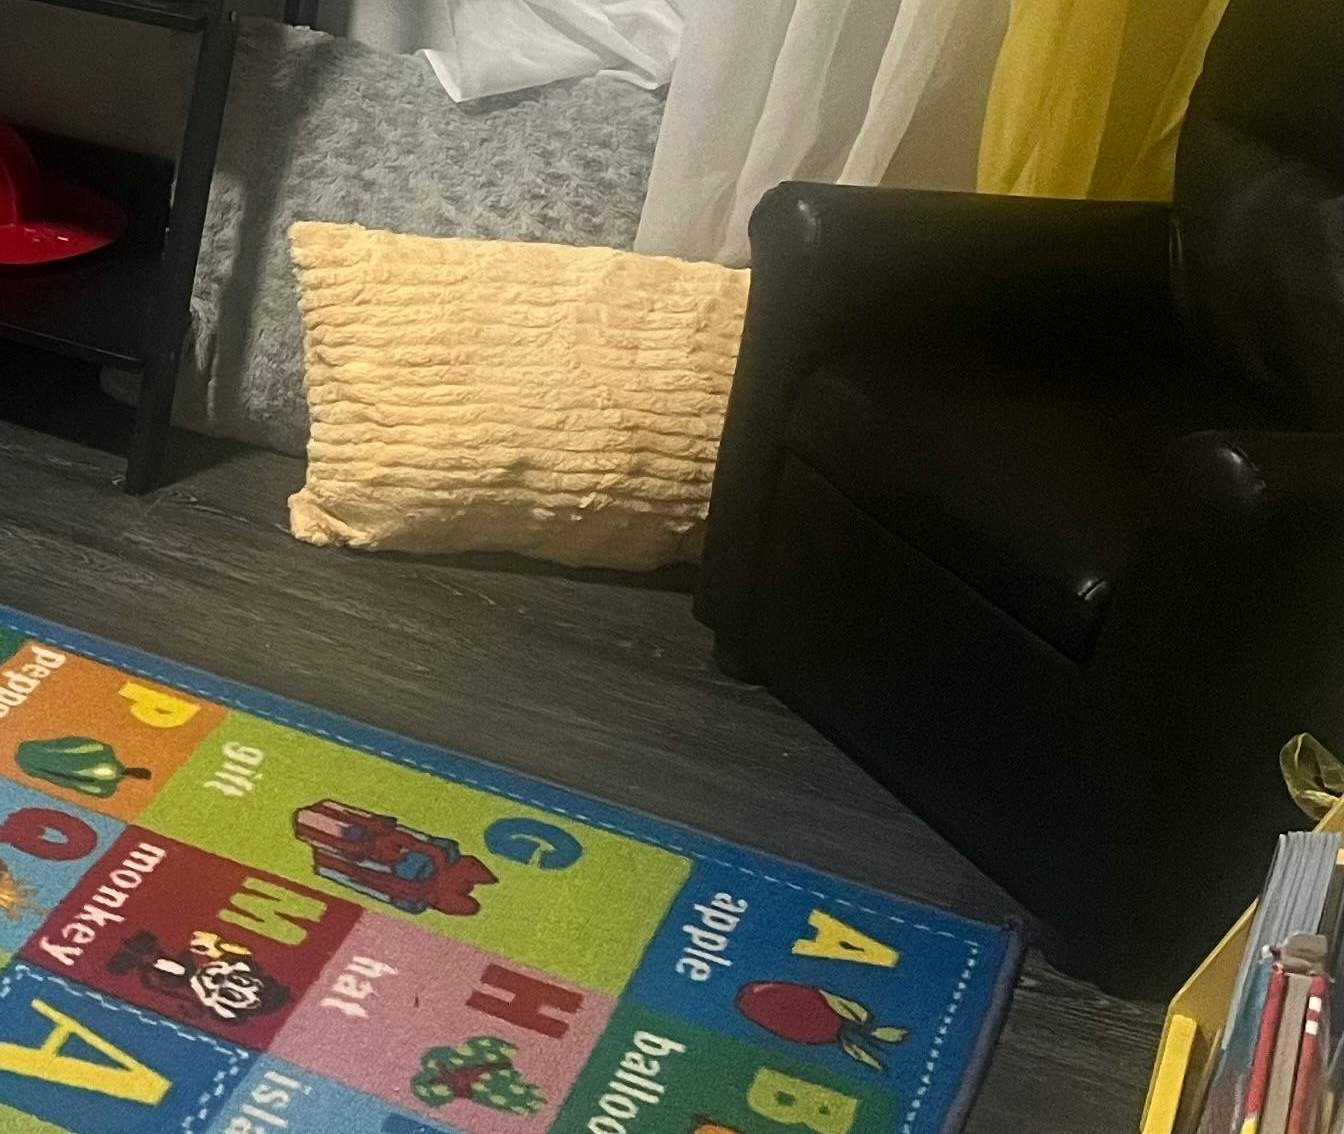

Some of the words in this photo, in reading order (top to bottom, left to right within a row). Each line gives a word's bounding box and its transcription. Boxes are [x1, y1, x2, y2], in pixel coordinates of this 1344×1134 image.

[118, 681, 202, 729] P
[204, 741, 266, 798] gift
[483, 817, 583, 872] G
[40, 842, 168, 966] monkey
[218, 877, 329, 947] M
[675, 892, 749, 983] apple
[791, 908, 901, 968] A
[319, 956, 399, 1018] hat
[465, 963, 585, 1039] H
